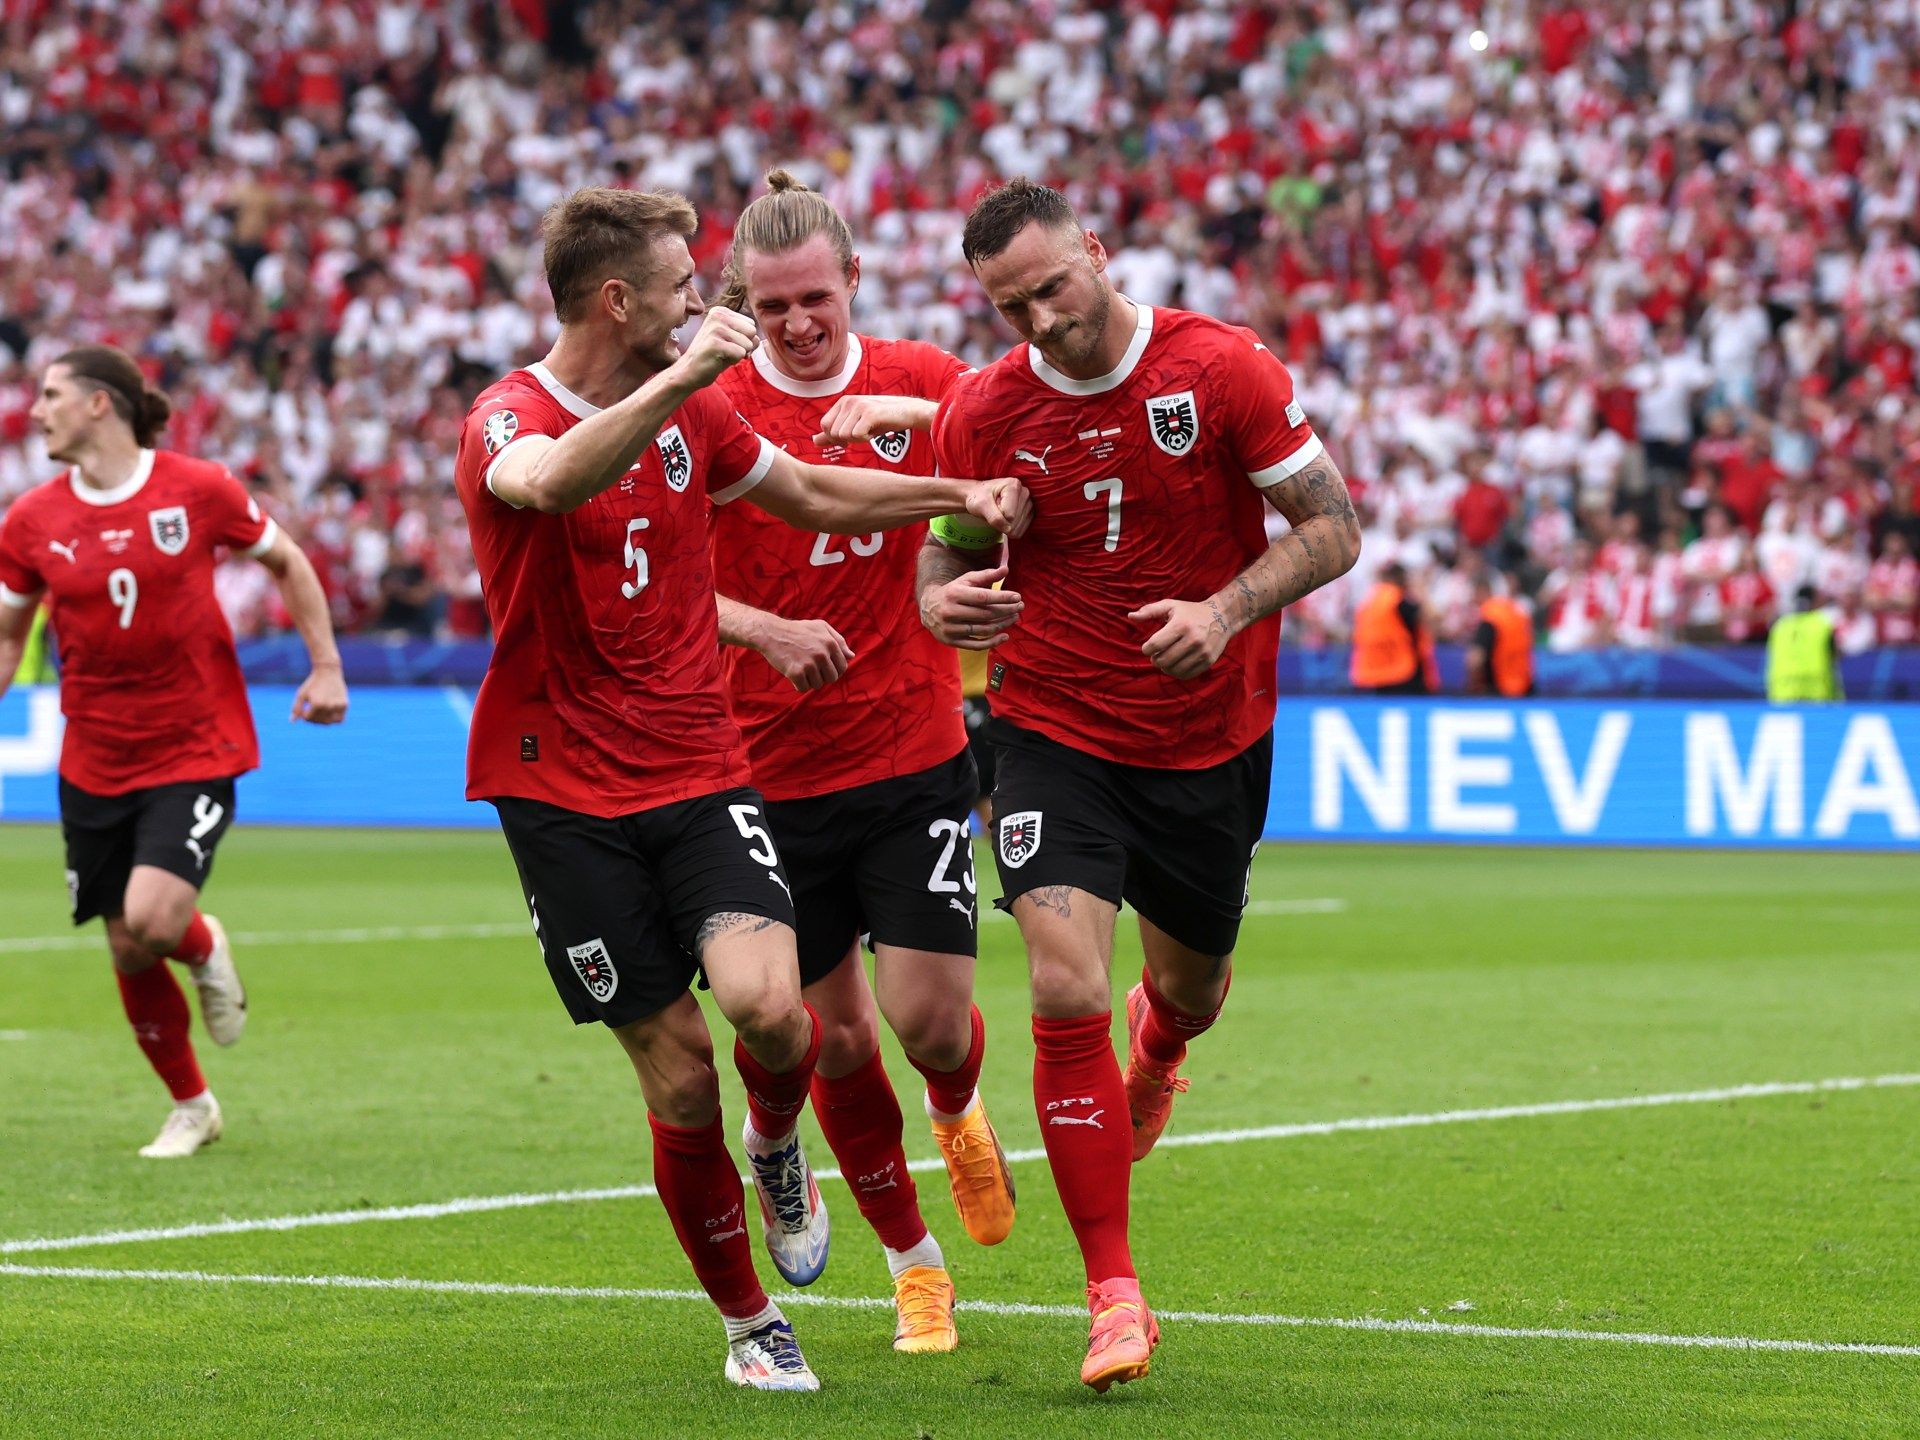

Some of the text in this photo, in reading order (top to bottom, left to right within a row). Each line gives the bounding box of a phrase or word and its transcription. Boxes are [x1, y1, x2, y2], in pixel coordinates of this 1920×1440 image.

[1083, 477, 1123, 553] 7
[621, 517, 650, 600] 5
[109, 568, 137, 629] 9
[1311, 709, 1920, 838] NEV MA
[727, 804, 778, 868] 5
